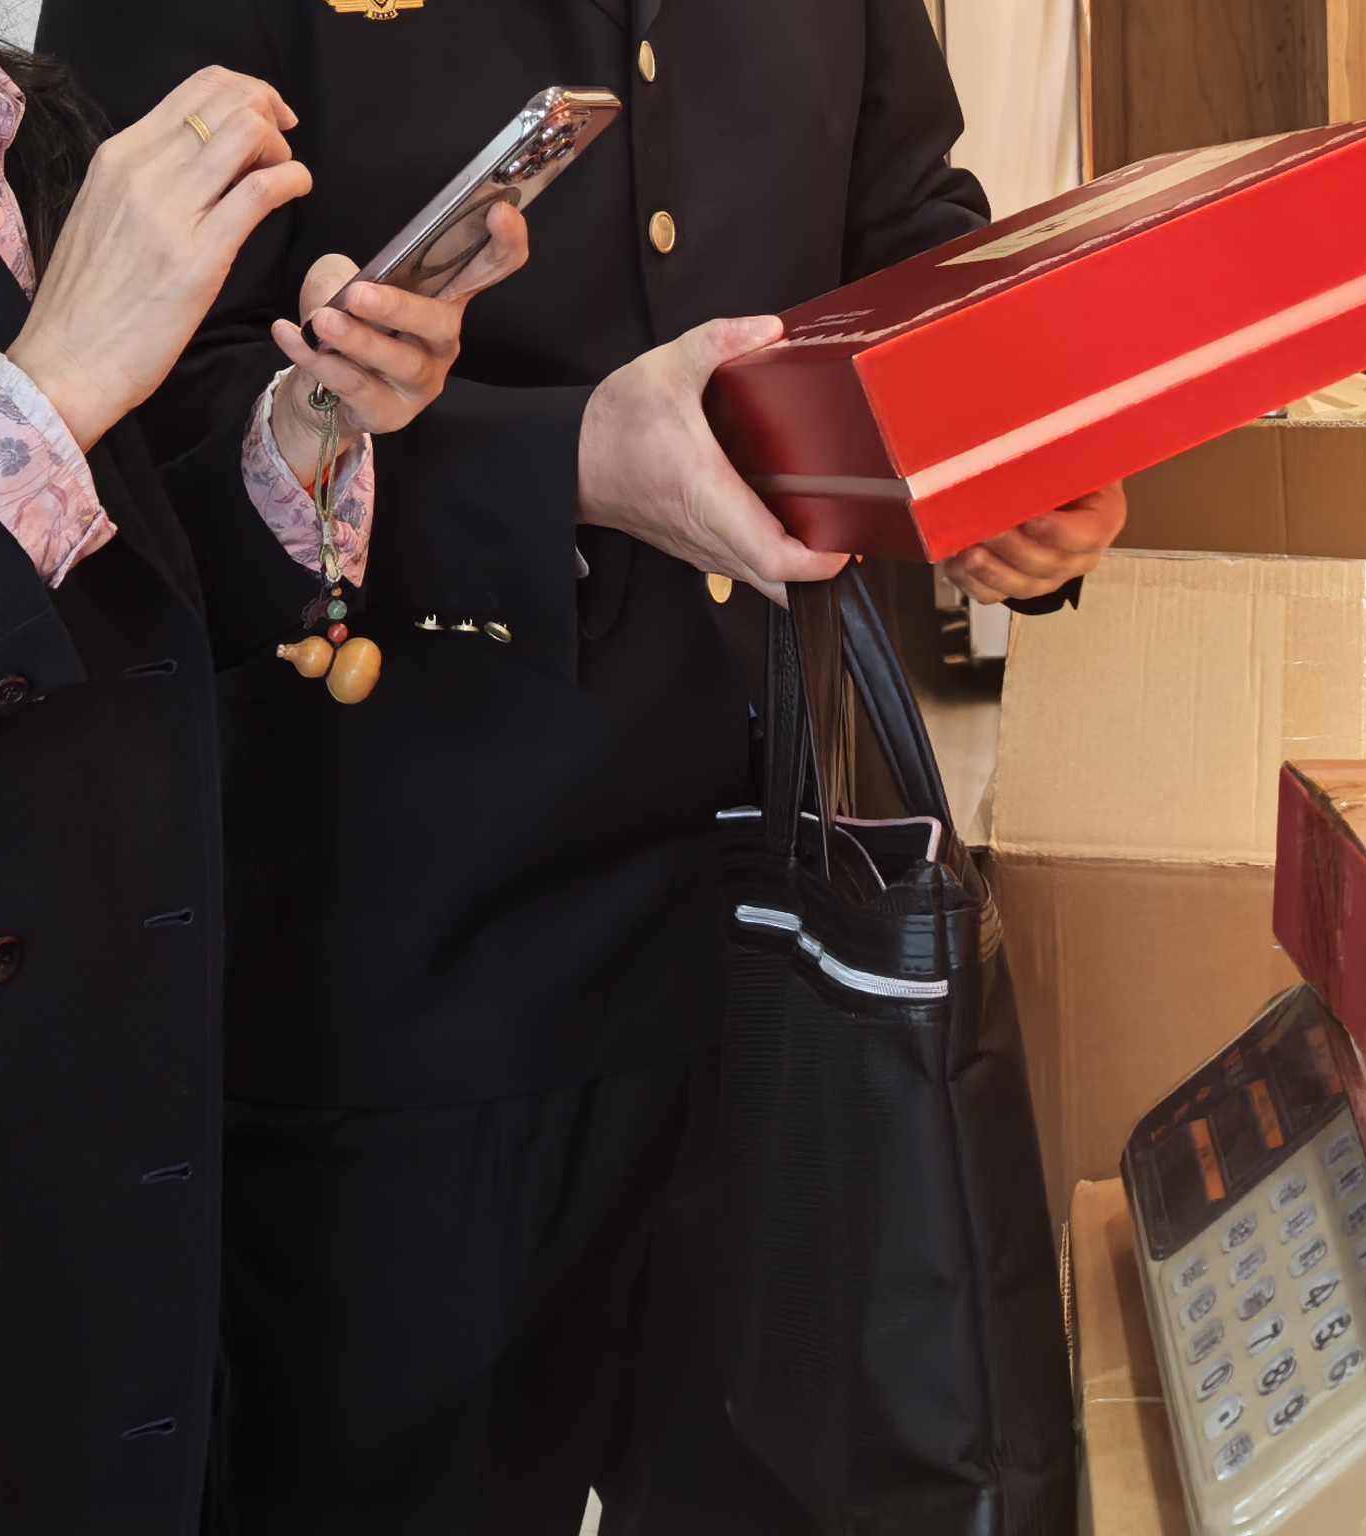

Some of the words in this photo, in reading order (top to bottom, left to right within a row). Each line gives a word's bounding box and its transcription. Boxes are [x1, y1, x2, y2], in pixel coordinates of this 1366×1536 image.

[1303, 1280, 1340, 1313] 4
[1248, 1321, 1281, 1350] 7
[1261, 1355, 1295, 1395] 8
[1274, 1394, 1307, 1426] 9
